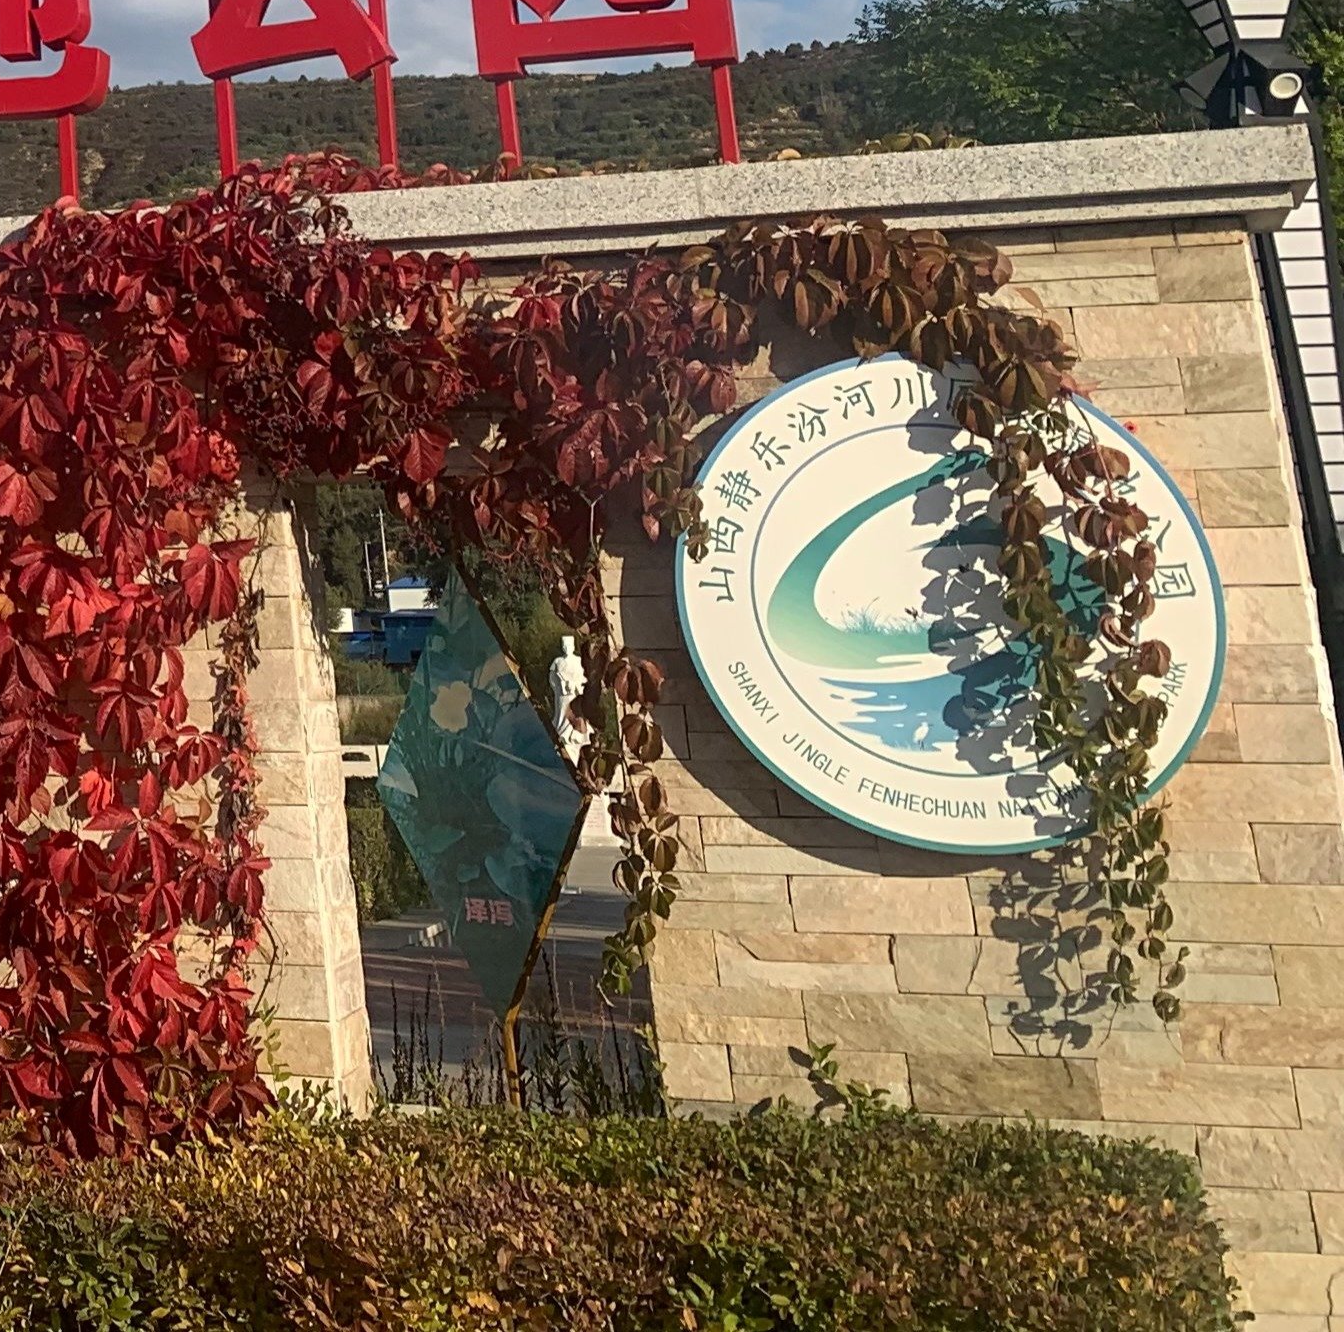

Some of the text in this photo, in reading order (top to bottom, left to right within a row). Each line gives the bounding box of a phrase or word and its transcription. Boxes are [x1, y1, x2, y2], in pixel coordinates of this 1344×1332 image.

[728, 661, 1188, 819] SHANXI JINGLE FENHECHUAN NATIONA PARK
